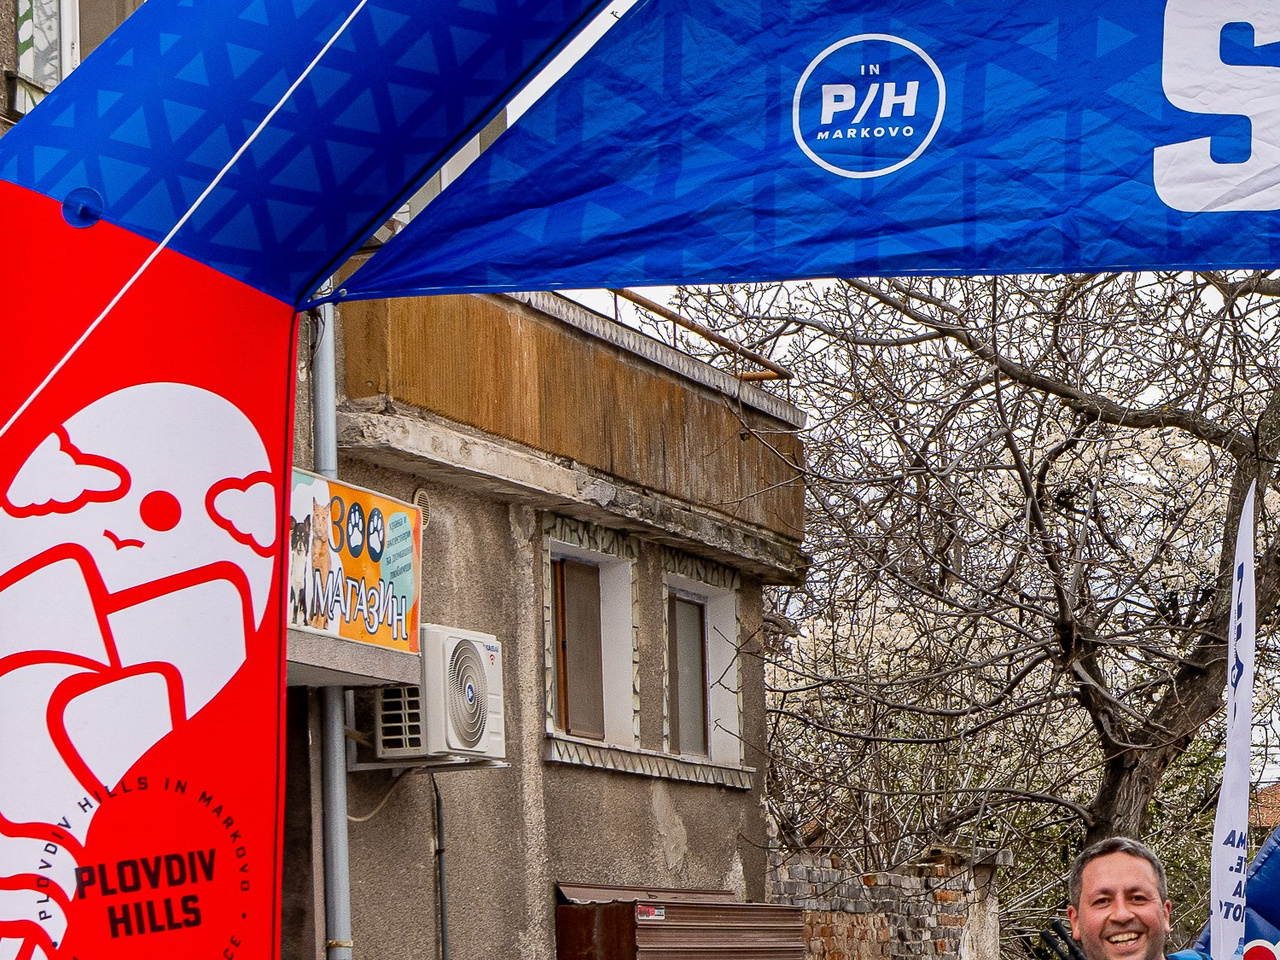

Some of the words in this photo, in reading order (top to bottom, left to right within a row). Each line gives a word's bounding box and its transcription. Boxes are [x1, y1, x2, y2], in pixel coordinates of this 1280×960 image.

[860, 64, 880, 75] IN
[820, 81, 919, 124] P/H
[816, 126, 914, 140] MARKOVO
[313, 567, 409, 641] МАГАЗИН
[37, 816, 72, 921] PLOVDIV
[77, 776, 148, 813] HILLS
[164, 777, 188, 794] IN
[199, 791, 250, 891] MARKOVO
[74, 848, 216, 900] PLOVDIV
[107, 894, 202, 939] HILLS
